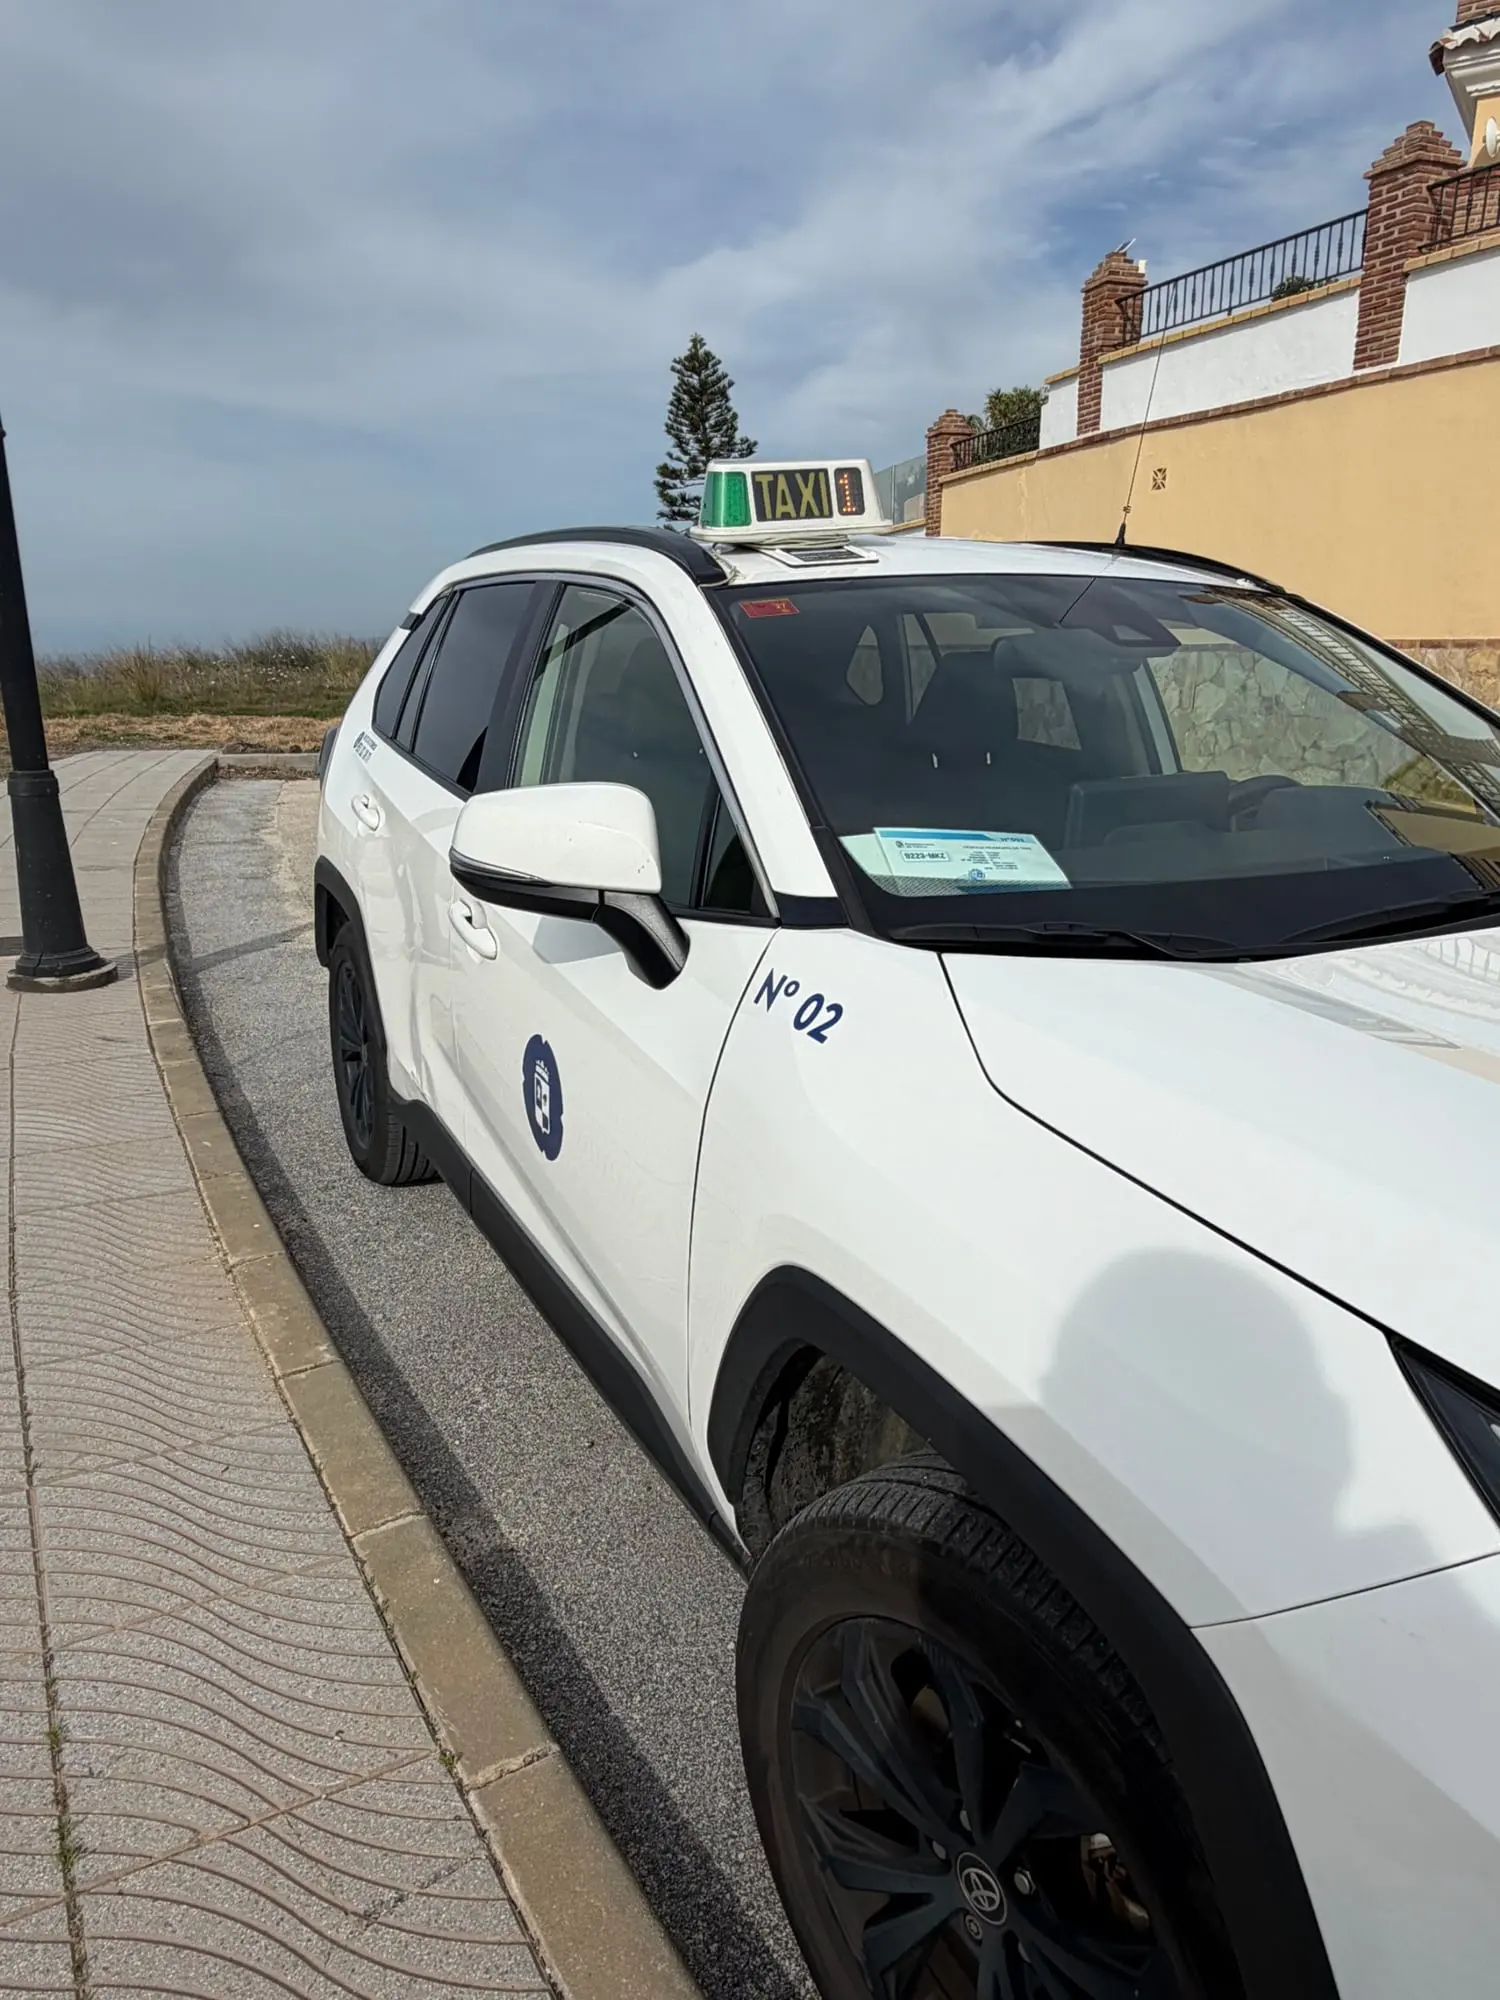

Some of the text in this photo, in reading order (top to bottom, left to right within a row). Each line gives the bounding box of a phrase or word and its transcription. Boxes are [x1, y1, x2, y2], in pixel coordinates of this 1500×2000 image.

[755, 473, 856, 519] TAXI 1
[793, 993, 843, 1044] 02
